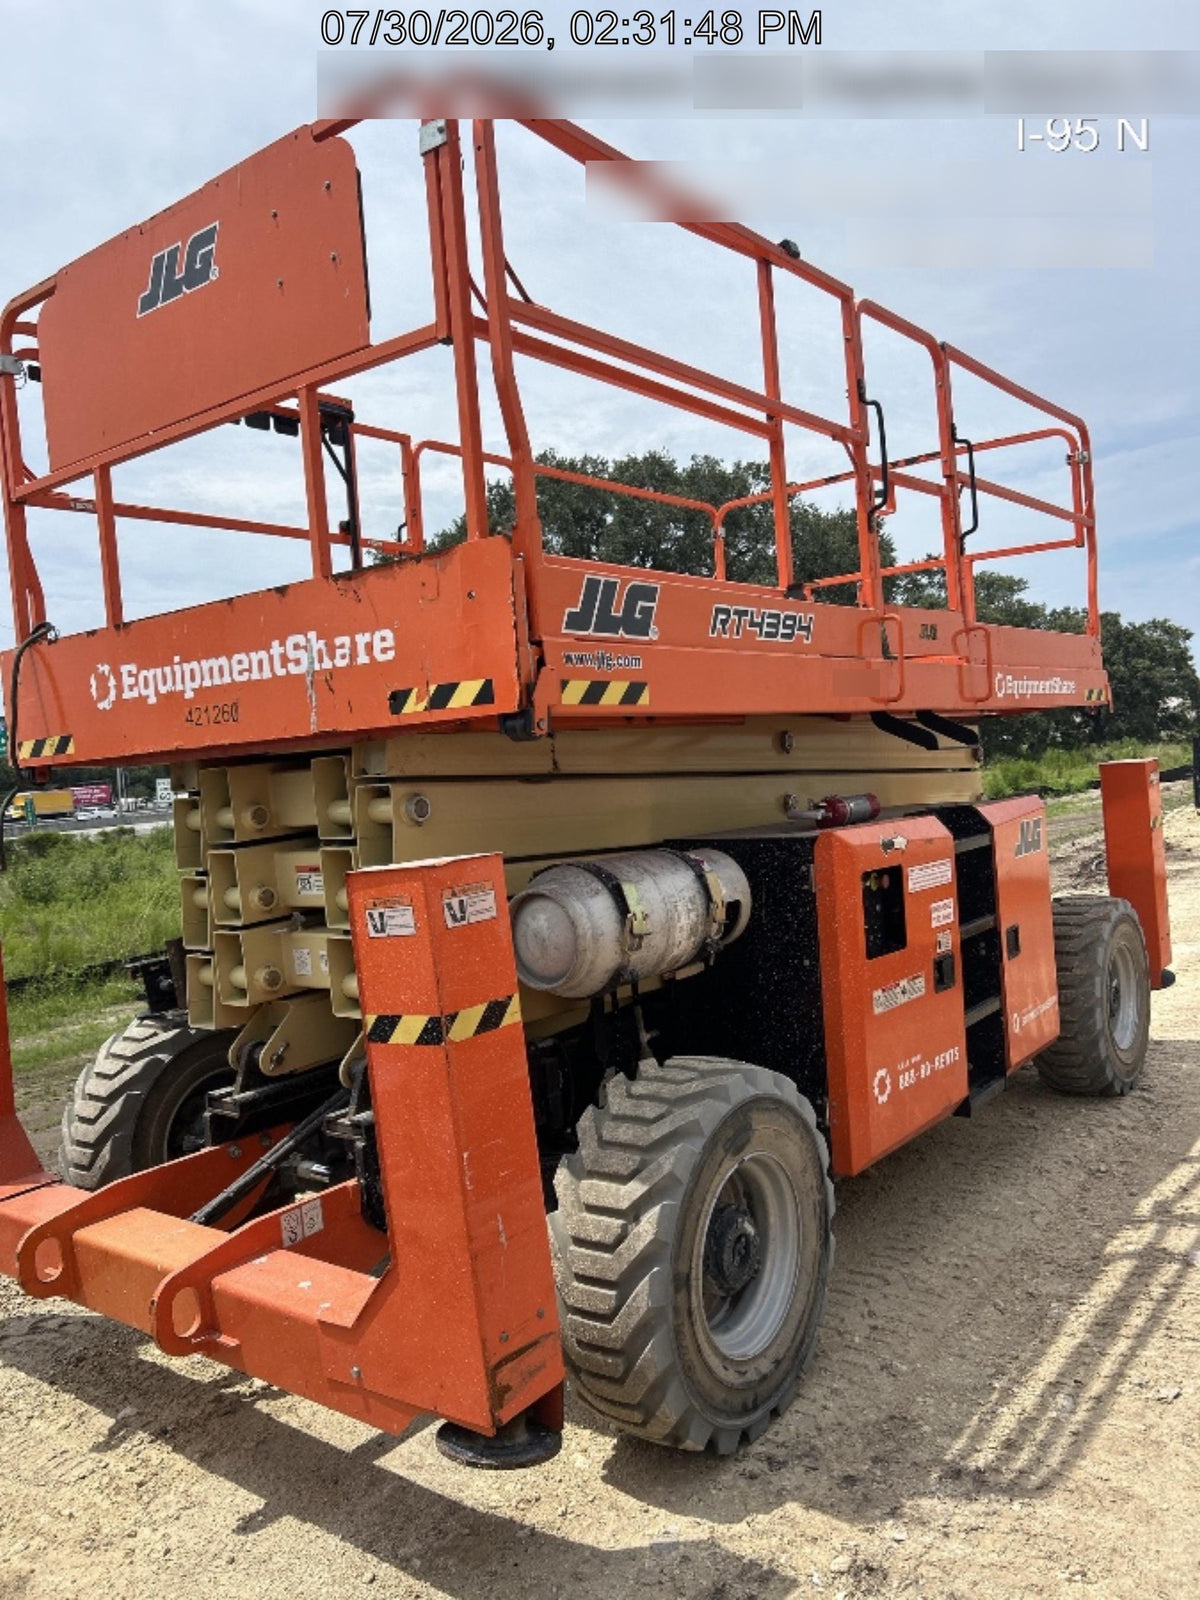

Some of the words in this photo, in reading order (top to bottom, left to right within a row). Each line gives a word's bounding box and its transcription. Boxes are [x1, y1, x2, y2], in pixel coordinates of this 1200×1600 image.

[136, 220, 219, 318] JLG
[562, 574, 660, 640] JLG
[709, 603, 814, 643] RT4394
[121, 628, 396, 705] EquipmentShare
[562, 650, 643, 670] www.jlg.com
[1005, 674, 1077, 700] EquipmentShare
[1015, 816, 1042, 858] JLG
